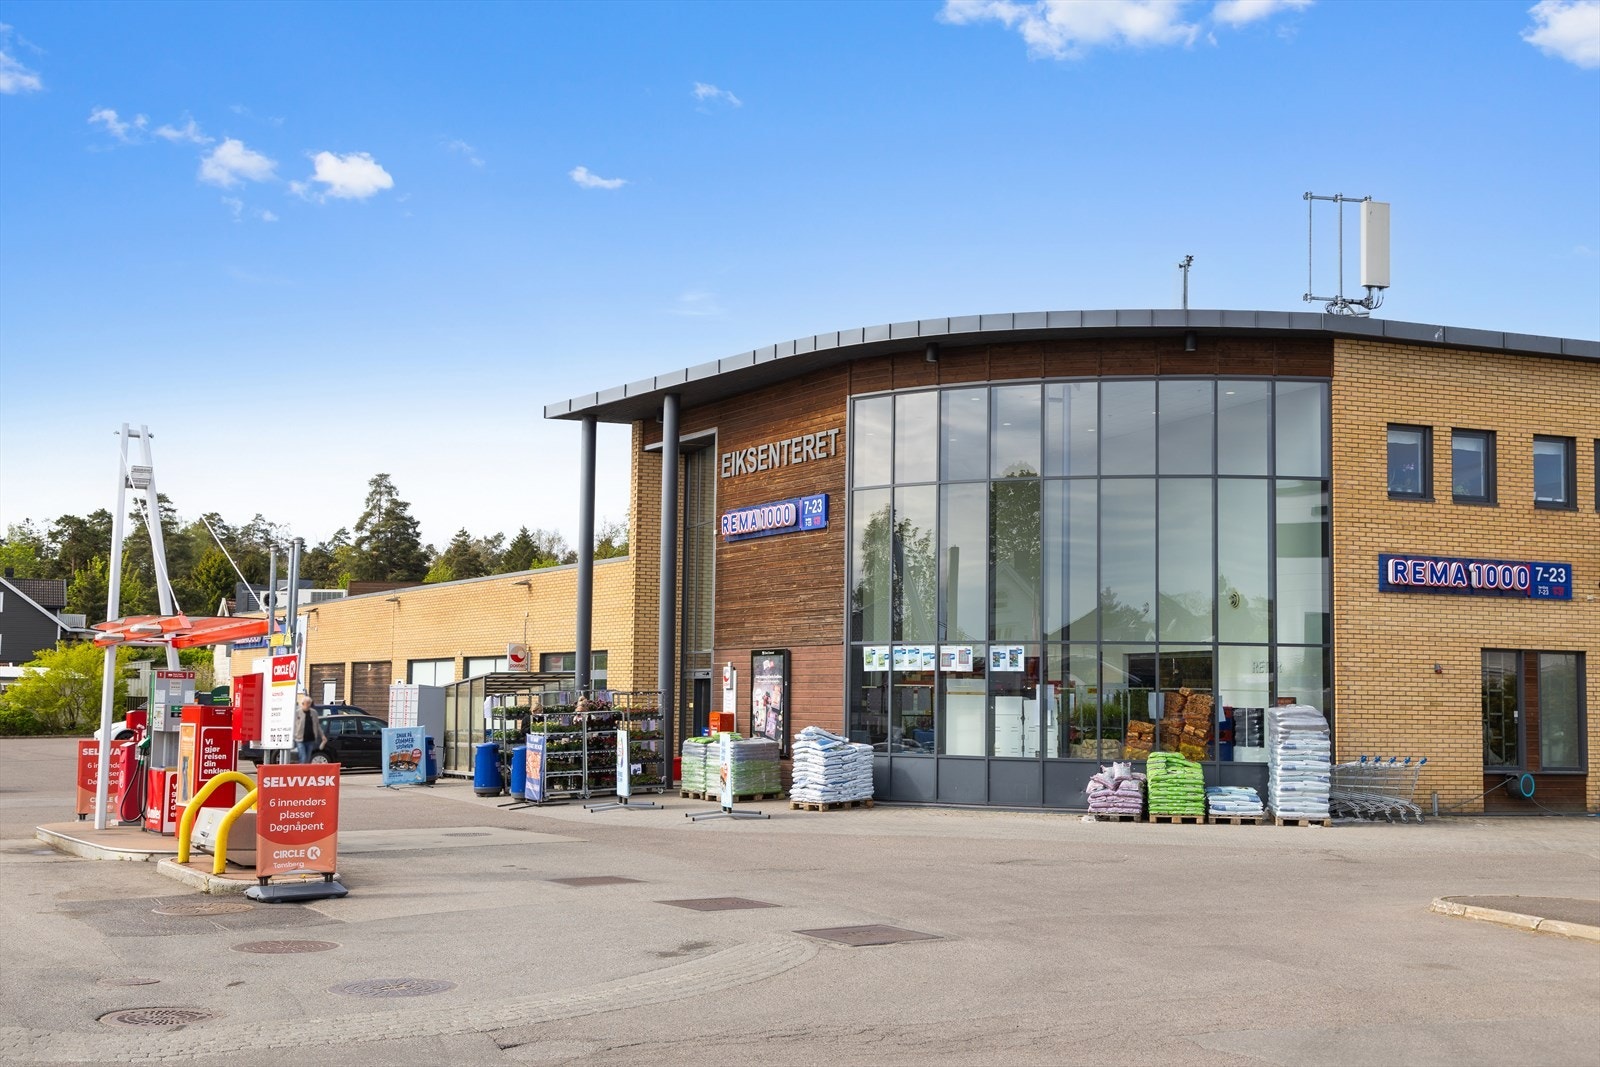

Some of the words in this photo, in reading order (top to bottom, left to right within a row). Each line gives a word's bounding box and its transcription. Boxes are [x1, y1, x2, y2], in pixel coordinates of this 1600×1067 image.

[721, 428, 840, 478] EIKSENTERET
[804, 499, 822, 514] 7-23
[722, 510, 760, 535] REMA
[761, 503, 797, 529] 1000
[1388, 559, 1468, 587] REMA
[1469, 563, 1530, 590] 1000
[1535, 567, 1566, 582] 7-23
[273, 665, 289, 676] CIRCLE
[263, 776, 336, 788] SELVVASK
[270, 798, 276, 807] 6
[278, 798, 326, 807] innendørs
[280, 811, 314, 820] plasser
[270, 821, 324, 833] Døgnåpent
[273, 850, 305, 858] CIRCLE
